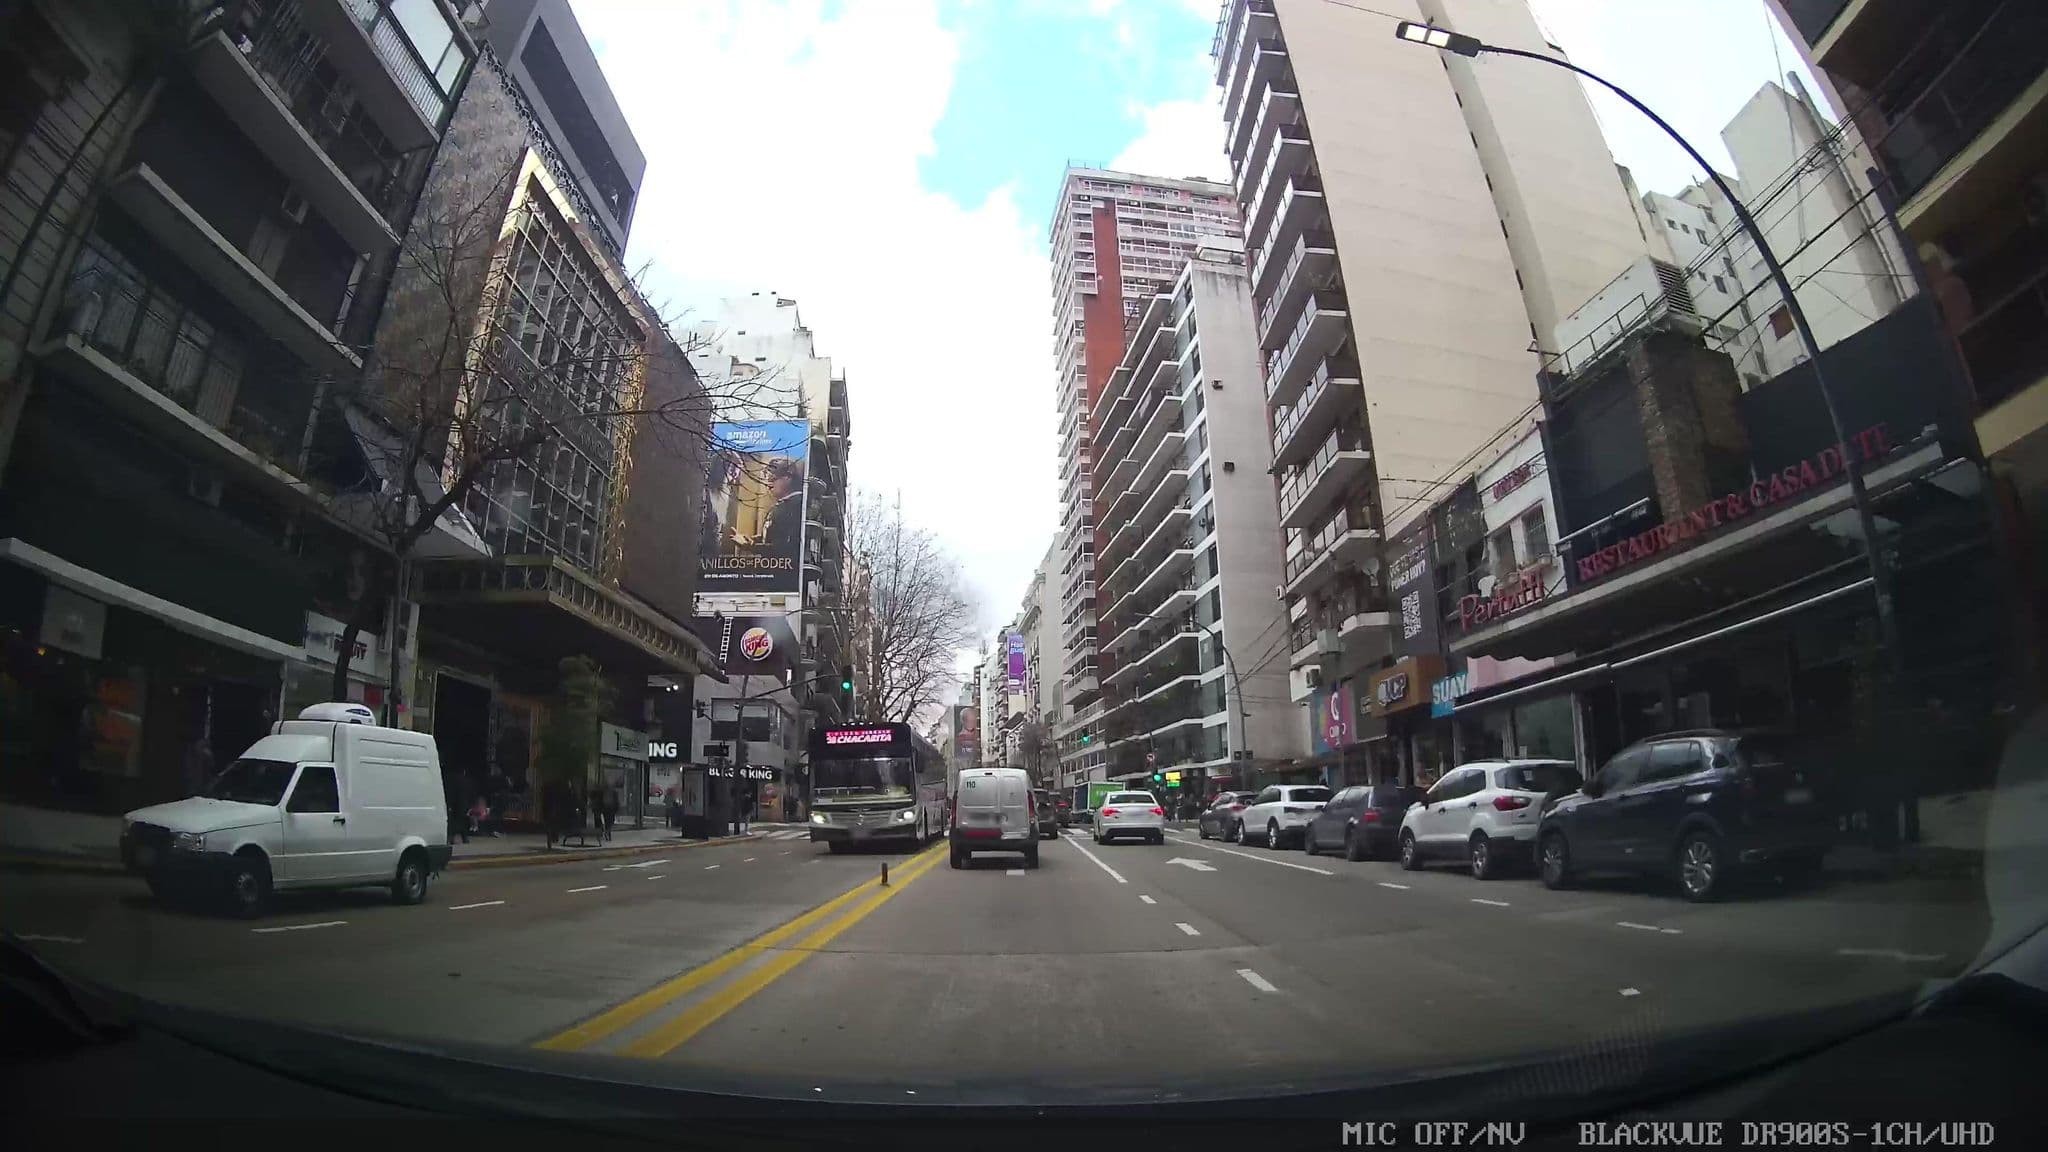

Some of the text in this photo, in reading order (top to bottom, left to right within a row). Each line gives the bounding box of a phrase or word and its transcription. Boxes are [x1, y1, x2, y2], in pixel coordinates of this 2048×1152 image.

[726, 430, 767, 440] amazon
[1750, 459, 1816, 508] CASA
[754, 557, 793, 570] PODER
[748, 769, 773, 779] KING
